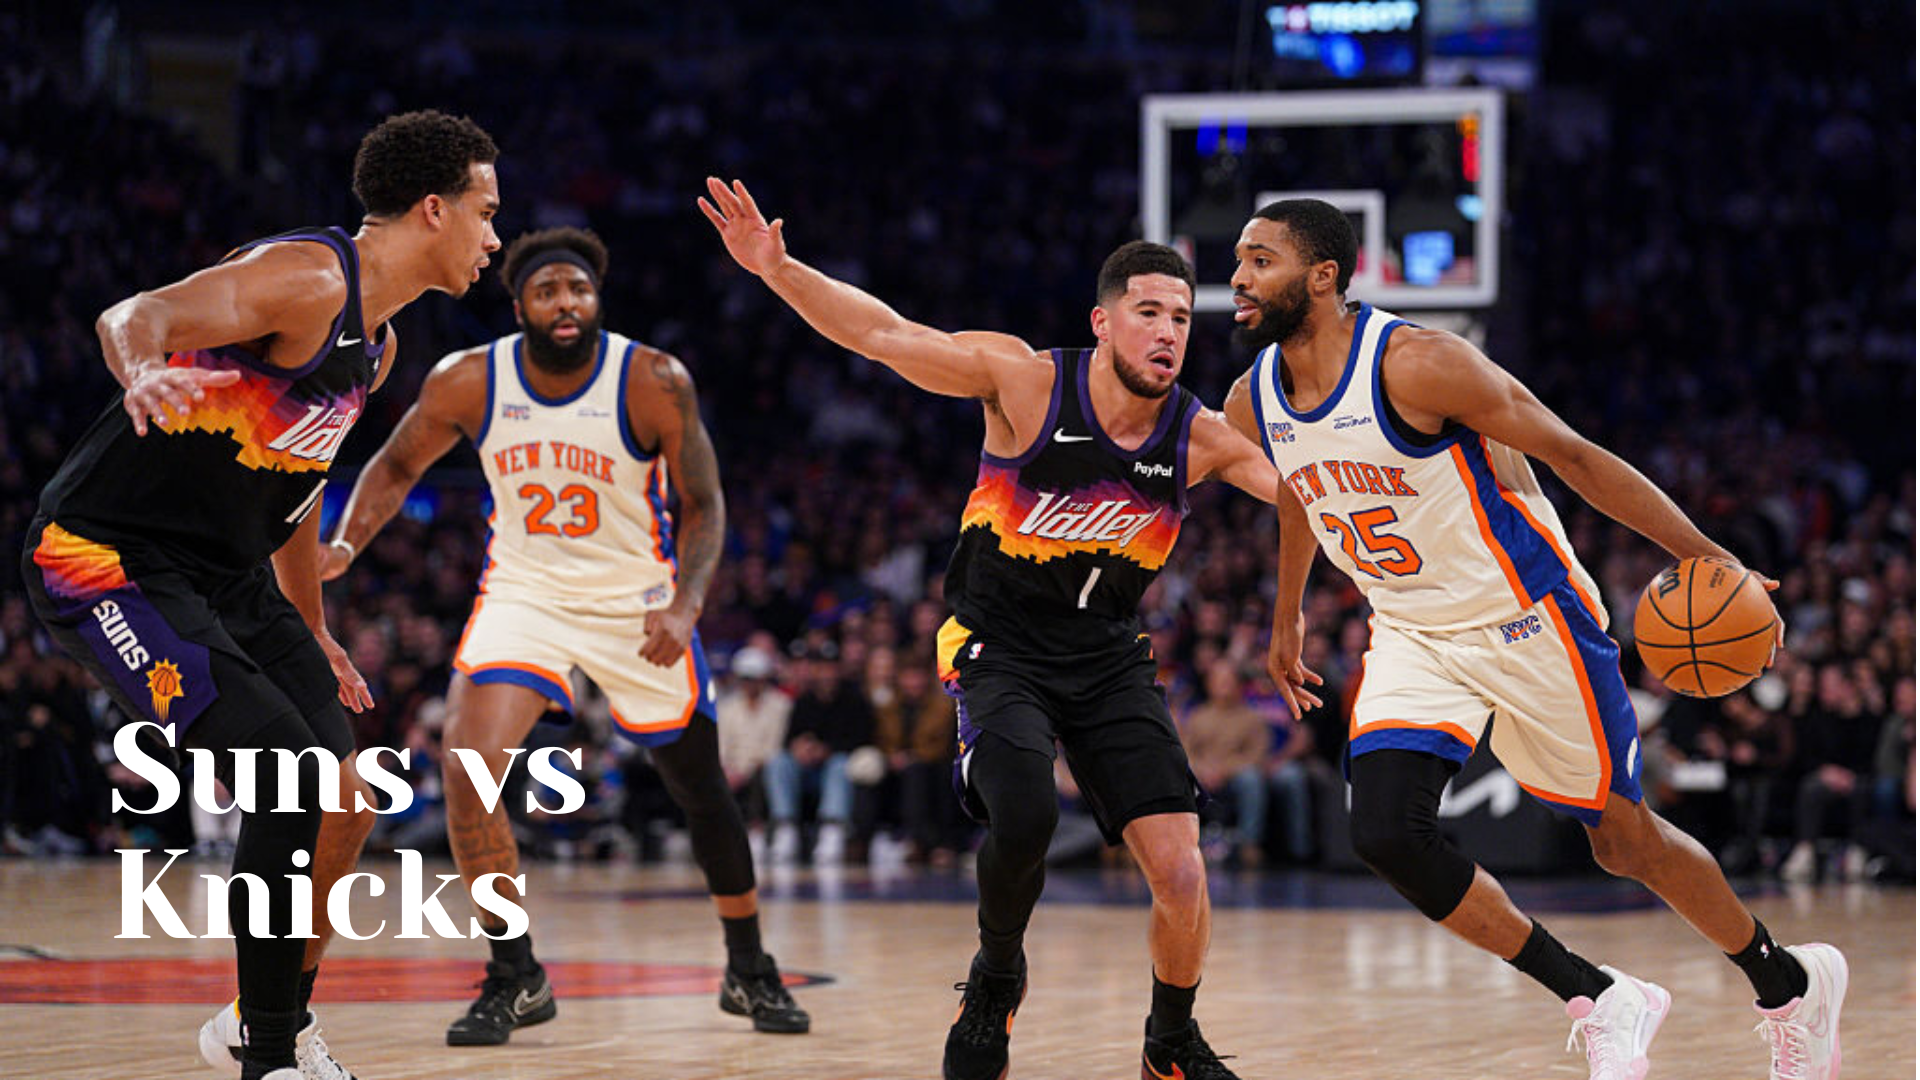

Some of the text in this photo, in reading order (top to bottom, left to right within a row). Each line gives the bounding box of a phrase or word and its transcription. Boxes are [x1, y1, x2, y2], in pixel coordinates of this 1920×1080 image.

[493, 440, 616, 486] NEW YORK
[1133, 461, 1174, 479] PayPal
[1322, 459, 1419, 497] YORK
[518, 482, 600, 538] 23
[1017, 492, 1163, 548] Valley
[1065, 502, 1093, 512] THE
[1319, 505, 1423, 581] 25
[1077, 566, 1102, 609] 1
[92, 599, 151, 671] SUNS
